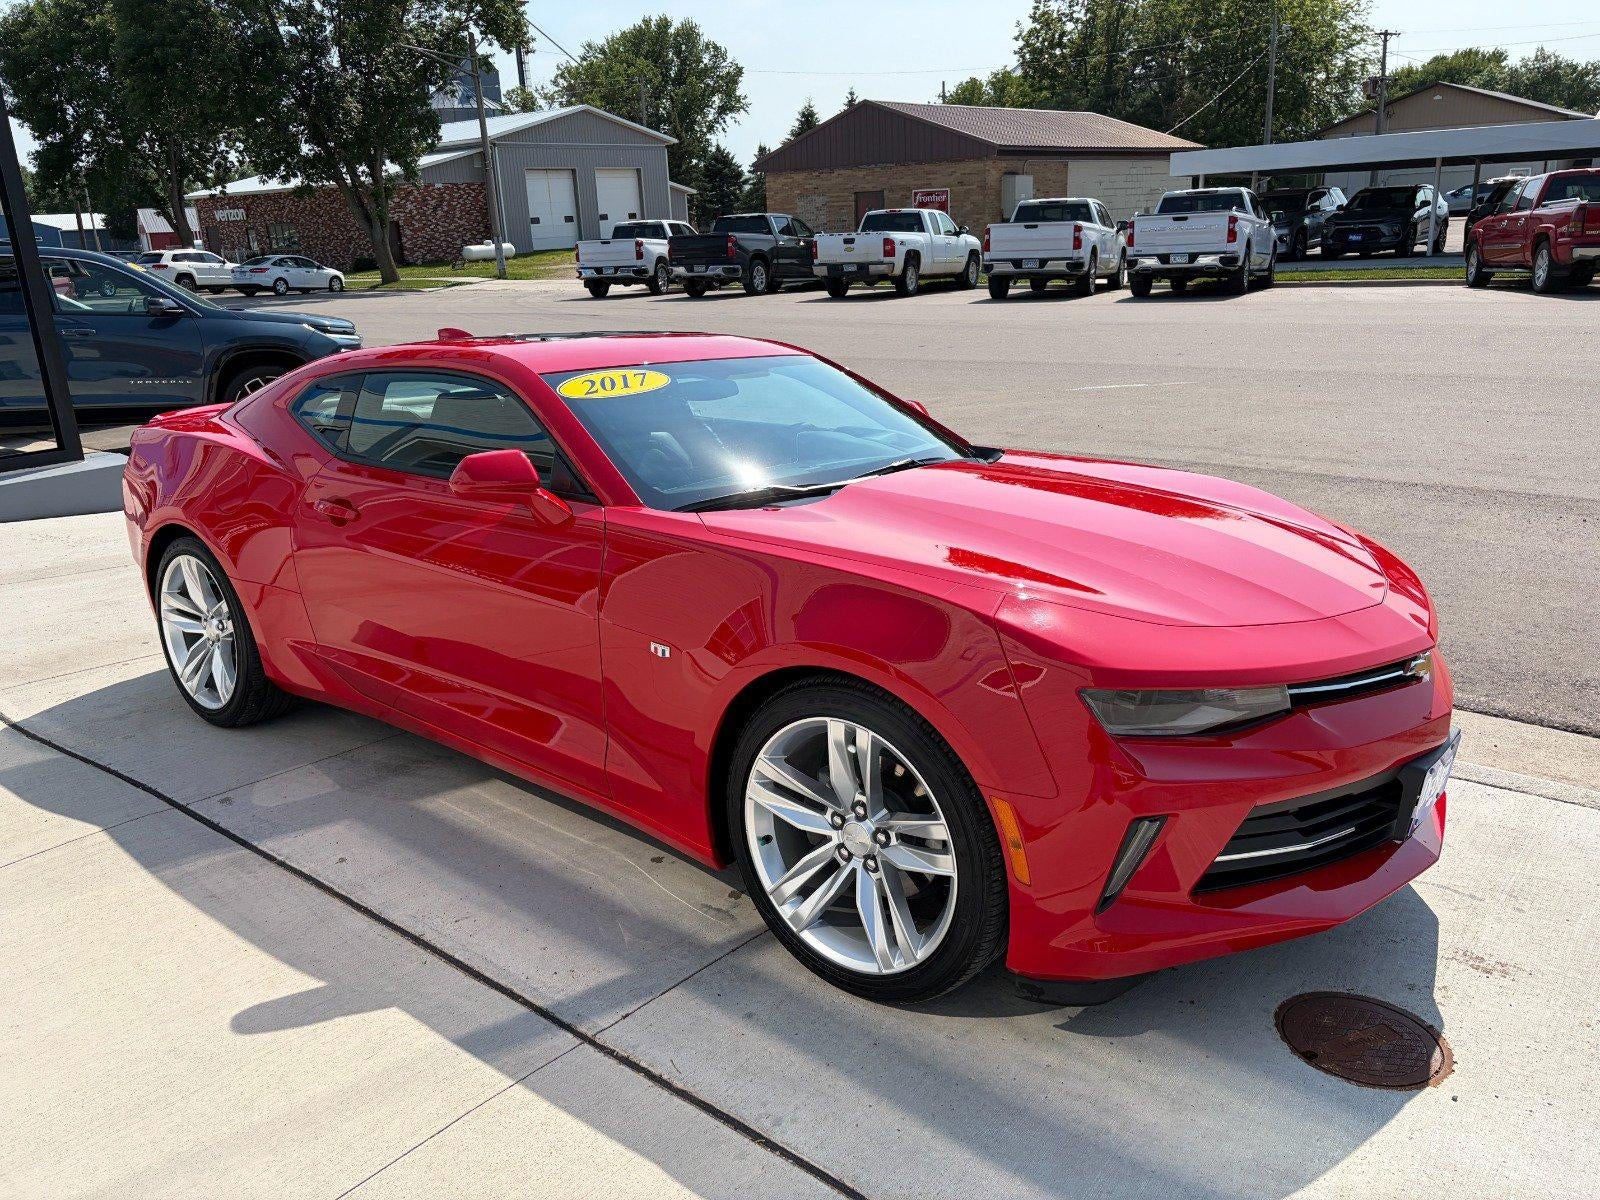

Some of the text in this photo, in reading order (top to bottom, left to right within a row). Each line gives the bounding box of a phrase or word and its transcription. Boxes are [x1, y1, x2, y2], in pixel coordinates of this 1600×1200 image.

[914, 193, 947, 205] frontier
[213, 206, 247, 221] verizon
[582, 372, 647, 395] 2017
